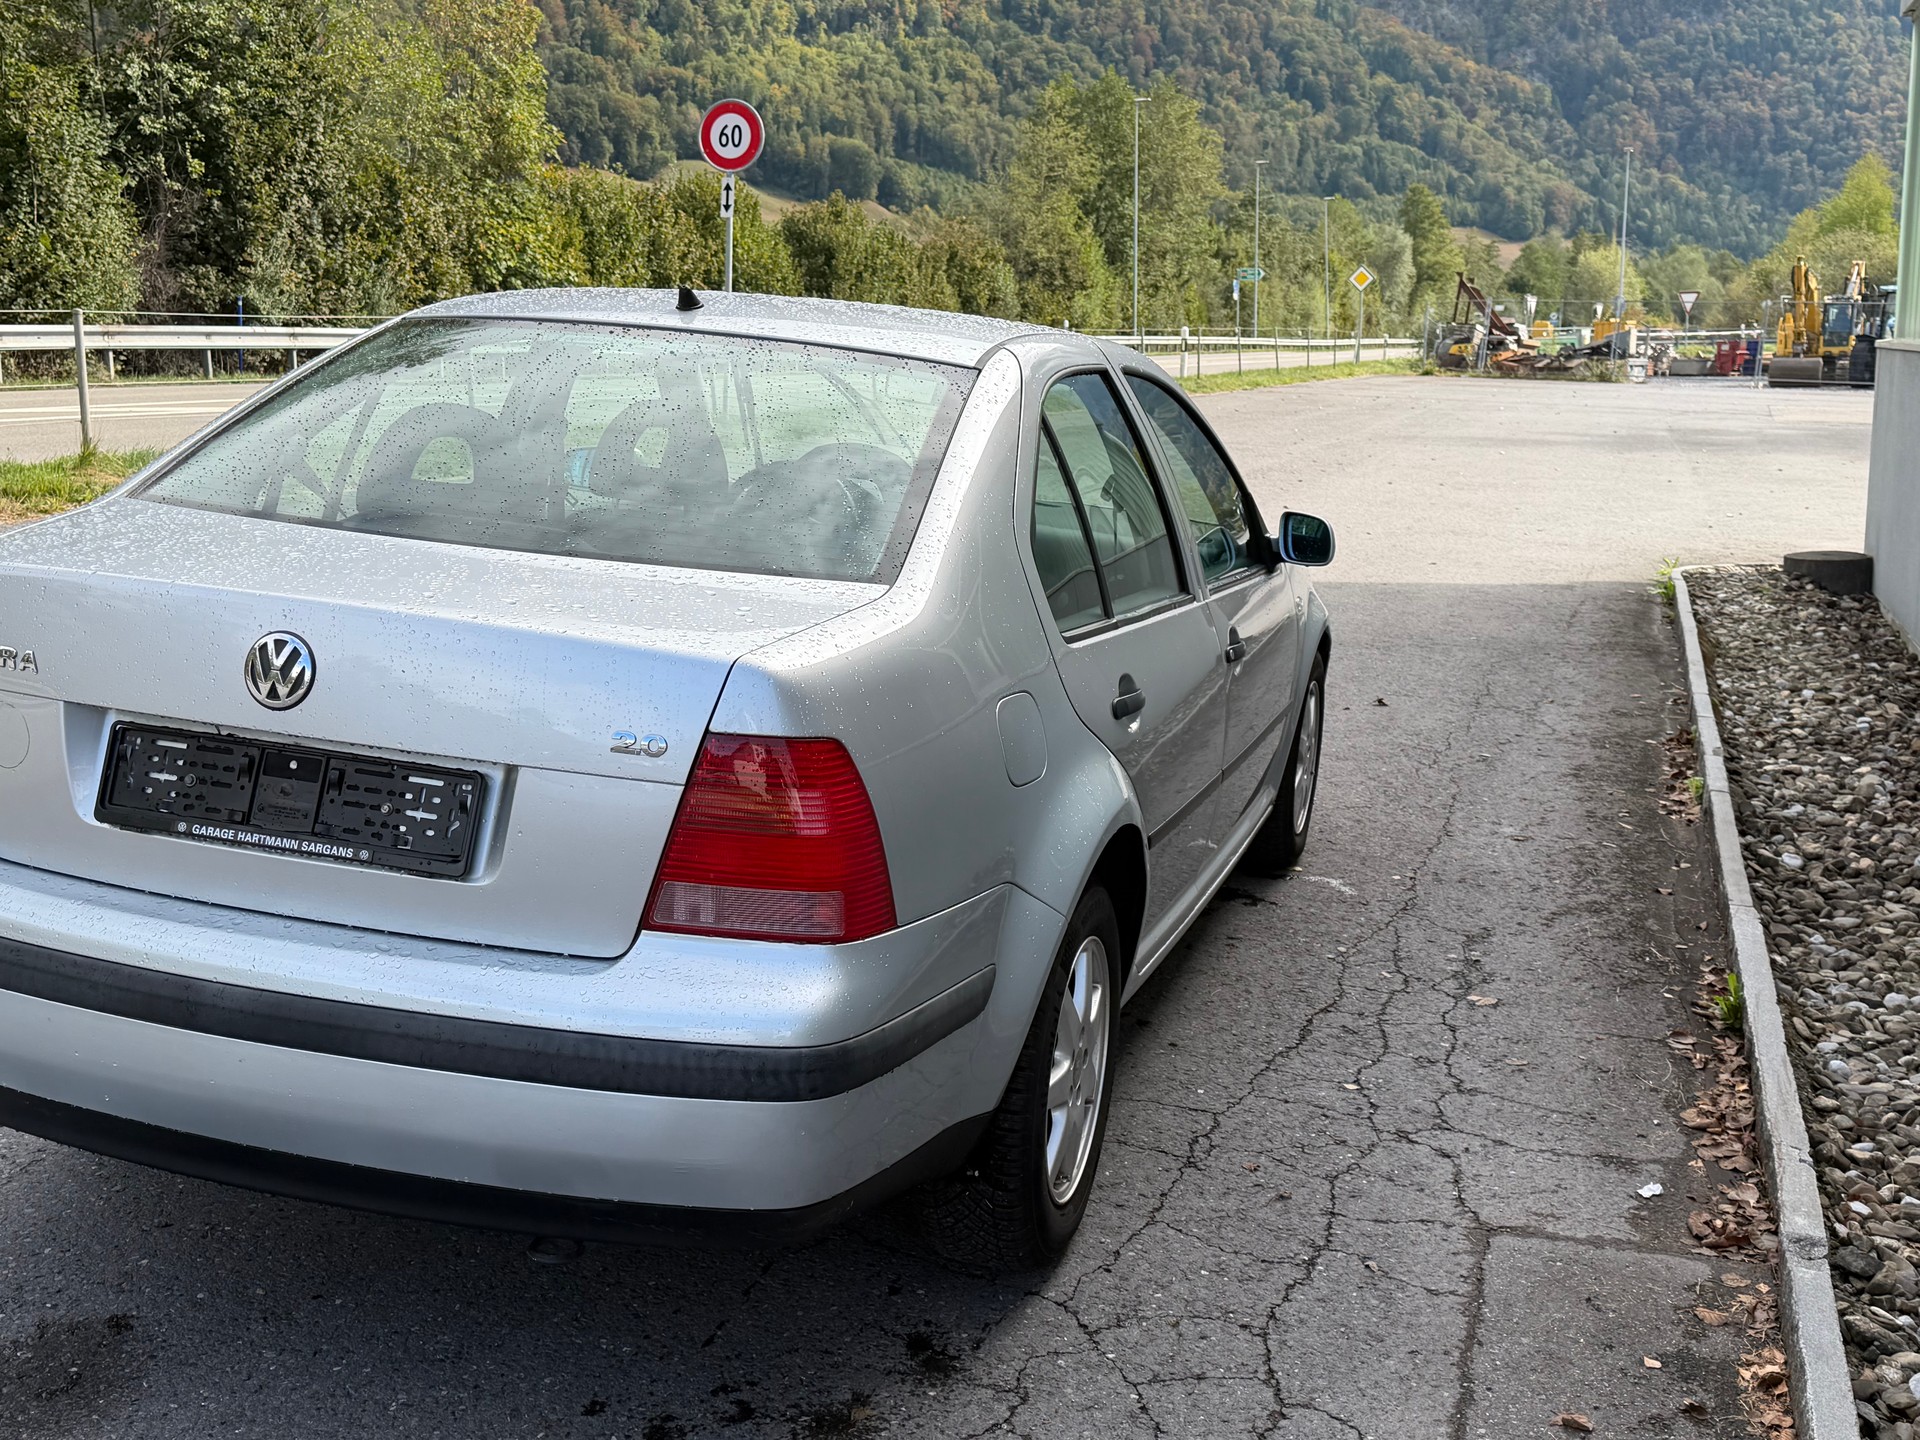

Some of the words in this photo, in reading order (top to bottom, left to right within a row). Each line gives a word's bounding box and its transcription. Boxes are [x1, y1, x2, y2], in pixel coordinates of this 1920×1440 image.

[719, 124, 742, 148] 60
[192, 824, 235, 840] GARAGE
[237, 831, 299, 849] HARTMANN
[301, 841, 354, 858] SARGANS
